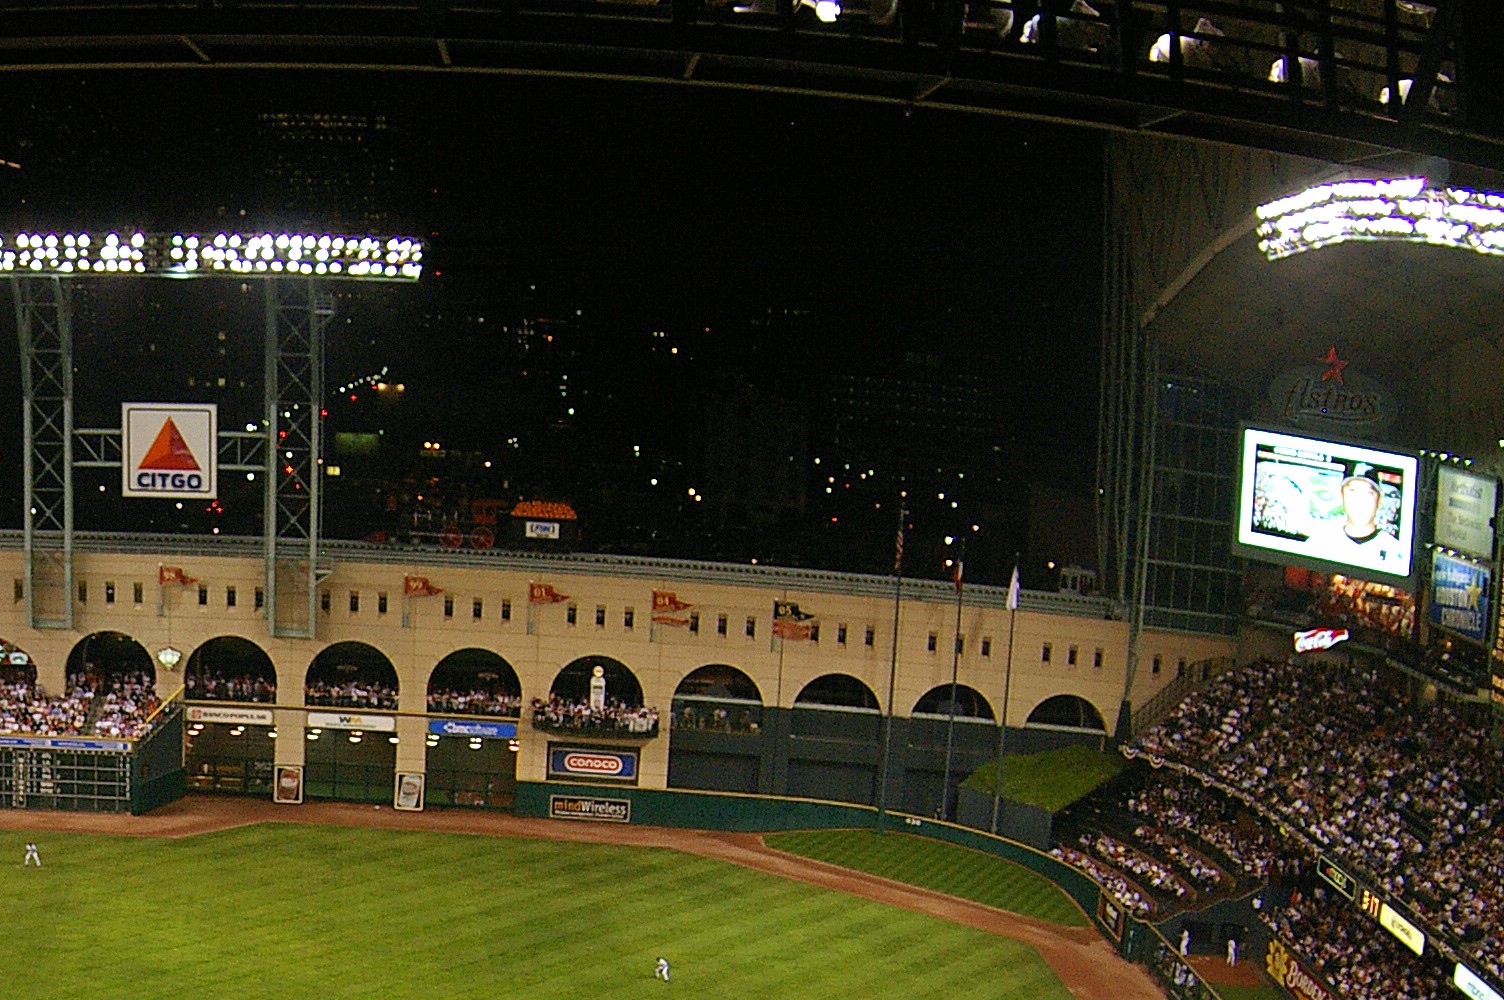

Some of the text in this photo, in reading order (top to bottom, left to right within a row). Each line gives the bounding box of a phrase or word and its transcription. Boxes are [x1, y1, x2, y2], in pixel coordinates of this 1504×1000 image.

[137, 472, 202, 489] CITGO
[570, 757, 618, 770] conoco
[555, 800, 627, 816] mindWireless
